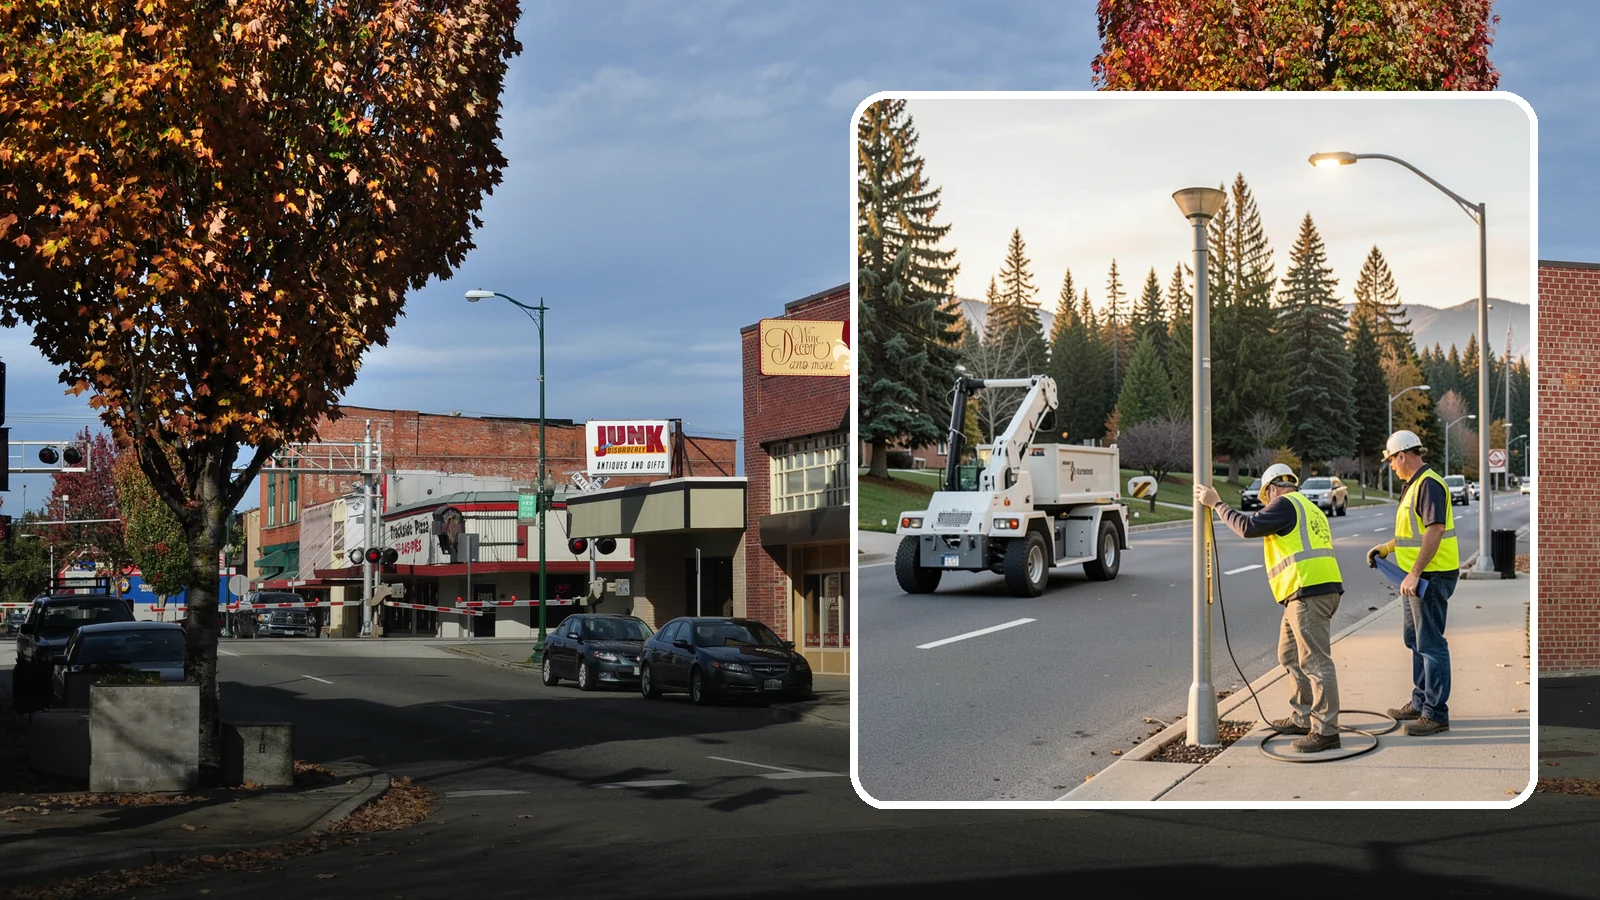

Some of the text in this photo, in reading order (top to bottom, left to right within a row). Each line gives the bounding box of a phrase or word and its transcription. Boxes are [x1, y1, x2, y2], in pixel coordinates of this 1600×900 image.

[596, 425, 665, 457] JUNK
[597, 460, 665, 470] ANTIQUES AND GIFTS
